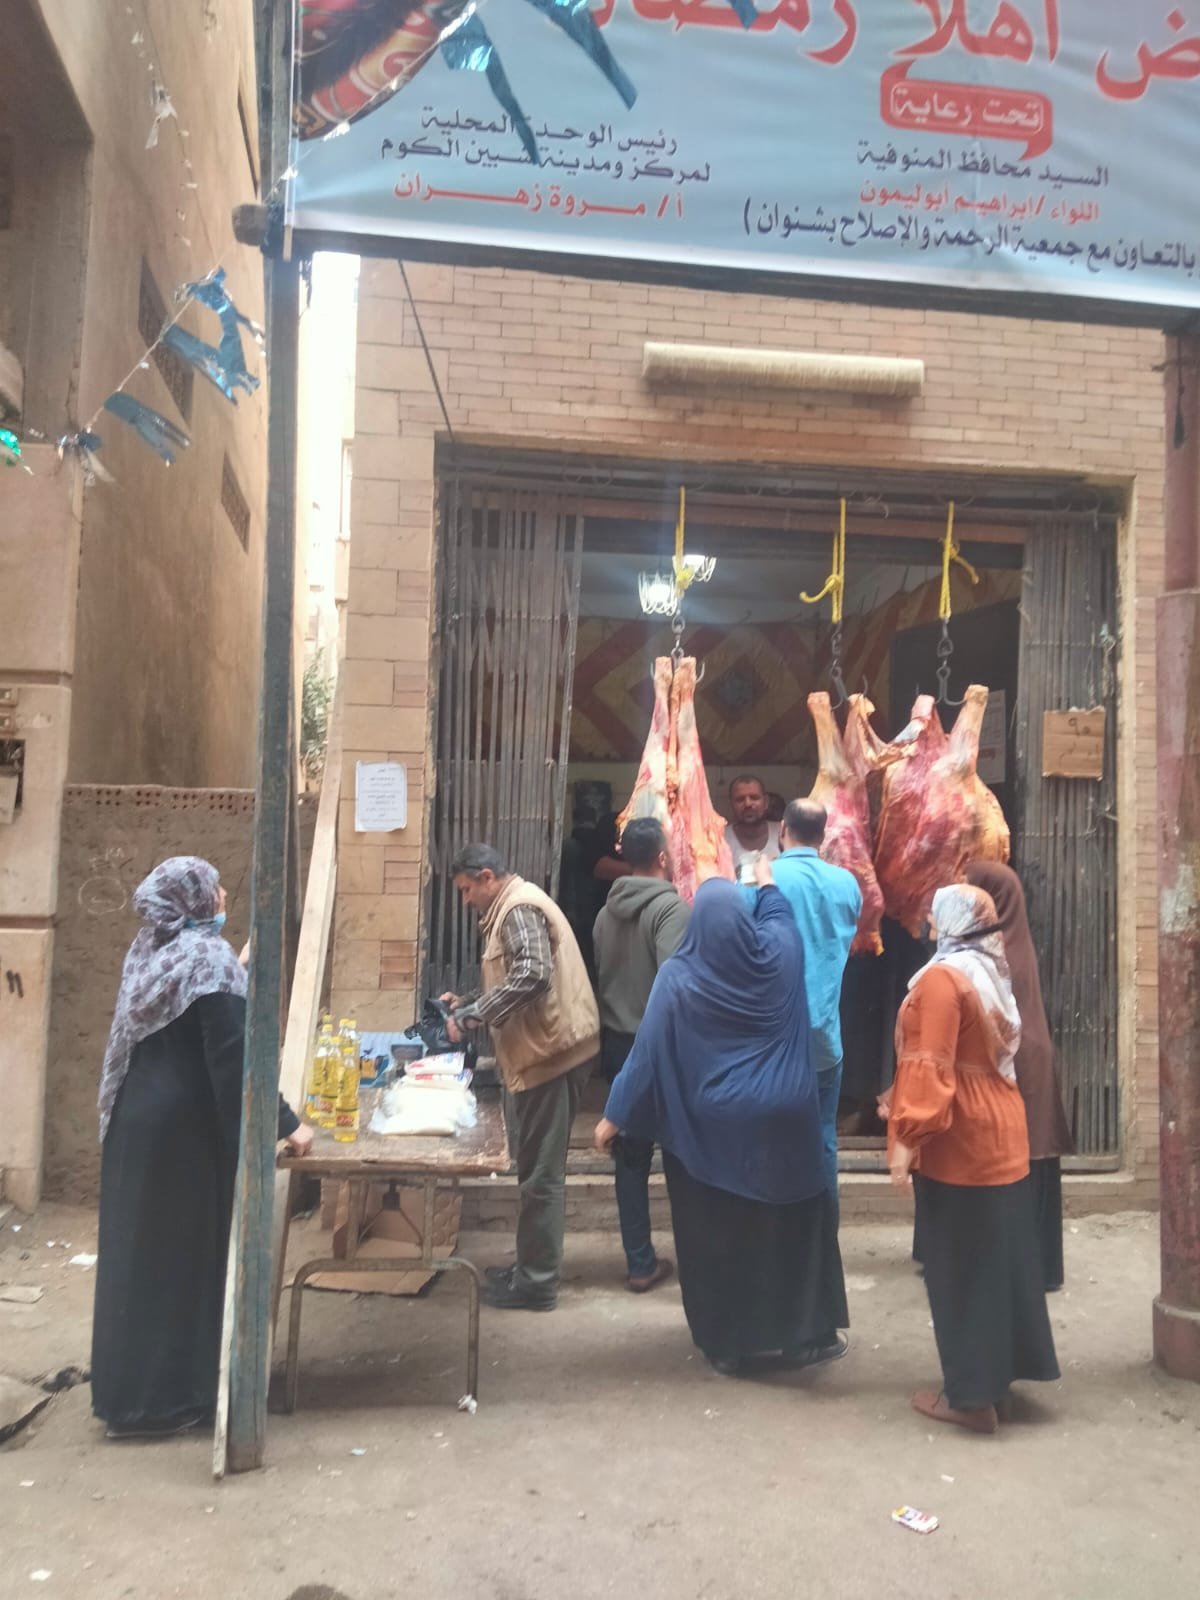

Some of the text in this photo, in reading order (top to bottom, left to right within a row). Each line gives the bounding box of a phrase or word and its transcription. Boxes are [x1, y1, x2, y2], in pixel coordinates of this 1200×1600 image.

[421, 106, 515, 135] المحلية
[894, 88, 1040, 128] تحت رعاية
[381, 136, 460, 160] الكوم
[617, 128, 678, 155] رئيس
[631, 156, 711, 185] لمركز
[857, 140, 1109, 189] السيد محافظ المنوفية
[394, 173, 543, 213] زهران
[549, 185, 646, 217] مروة
[934, 215, 1009, 256] الرحمة
[1013, 225, 1085, 265] جمعية
[1087, 242, 1111, 273] مع
